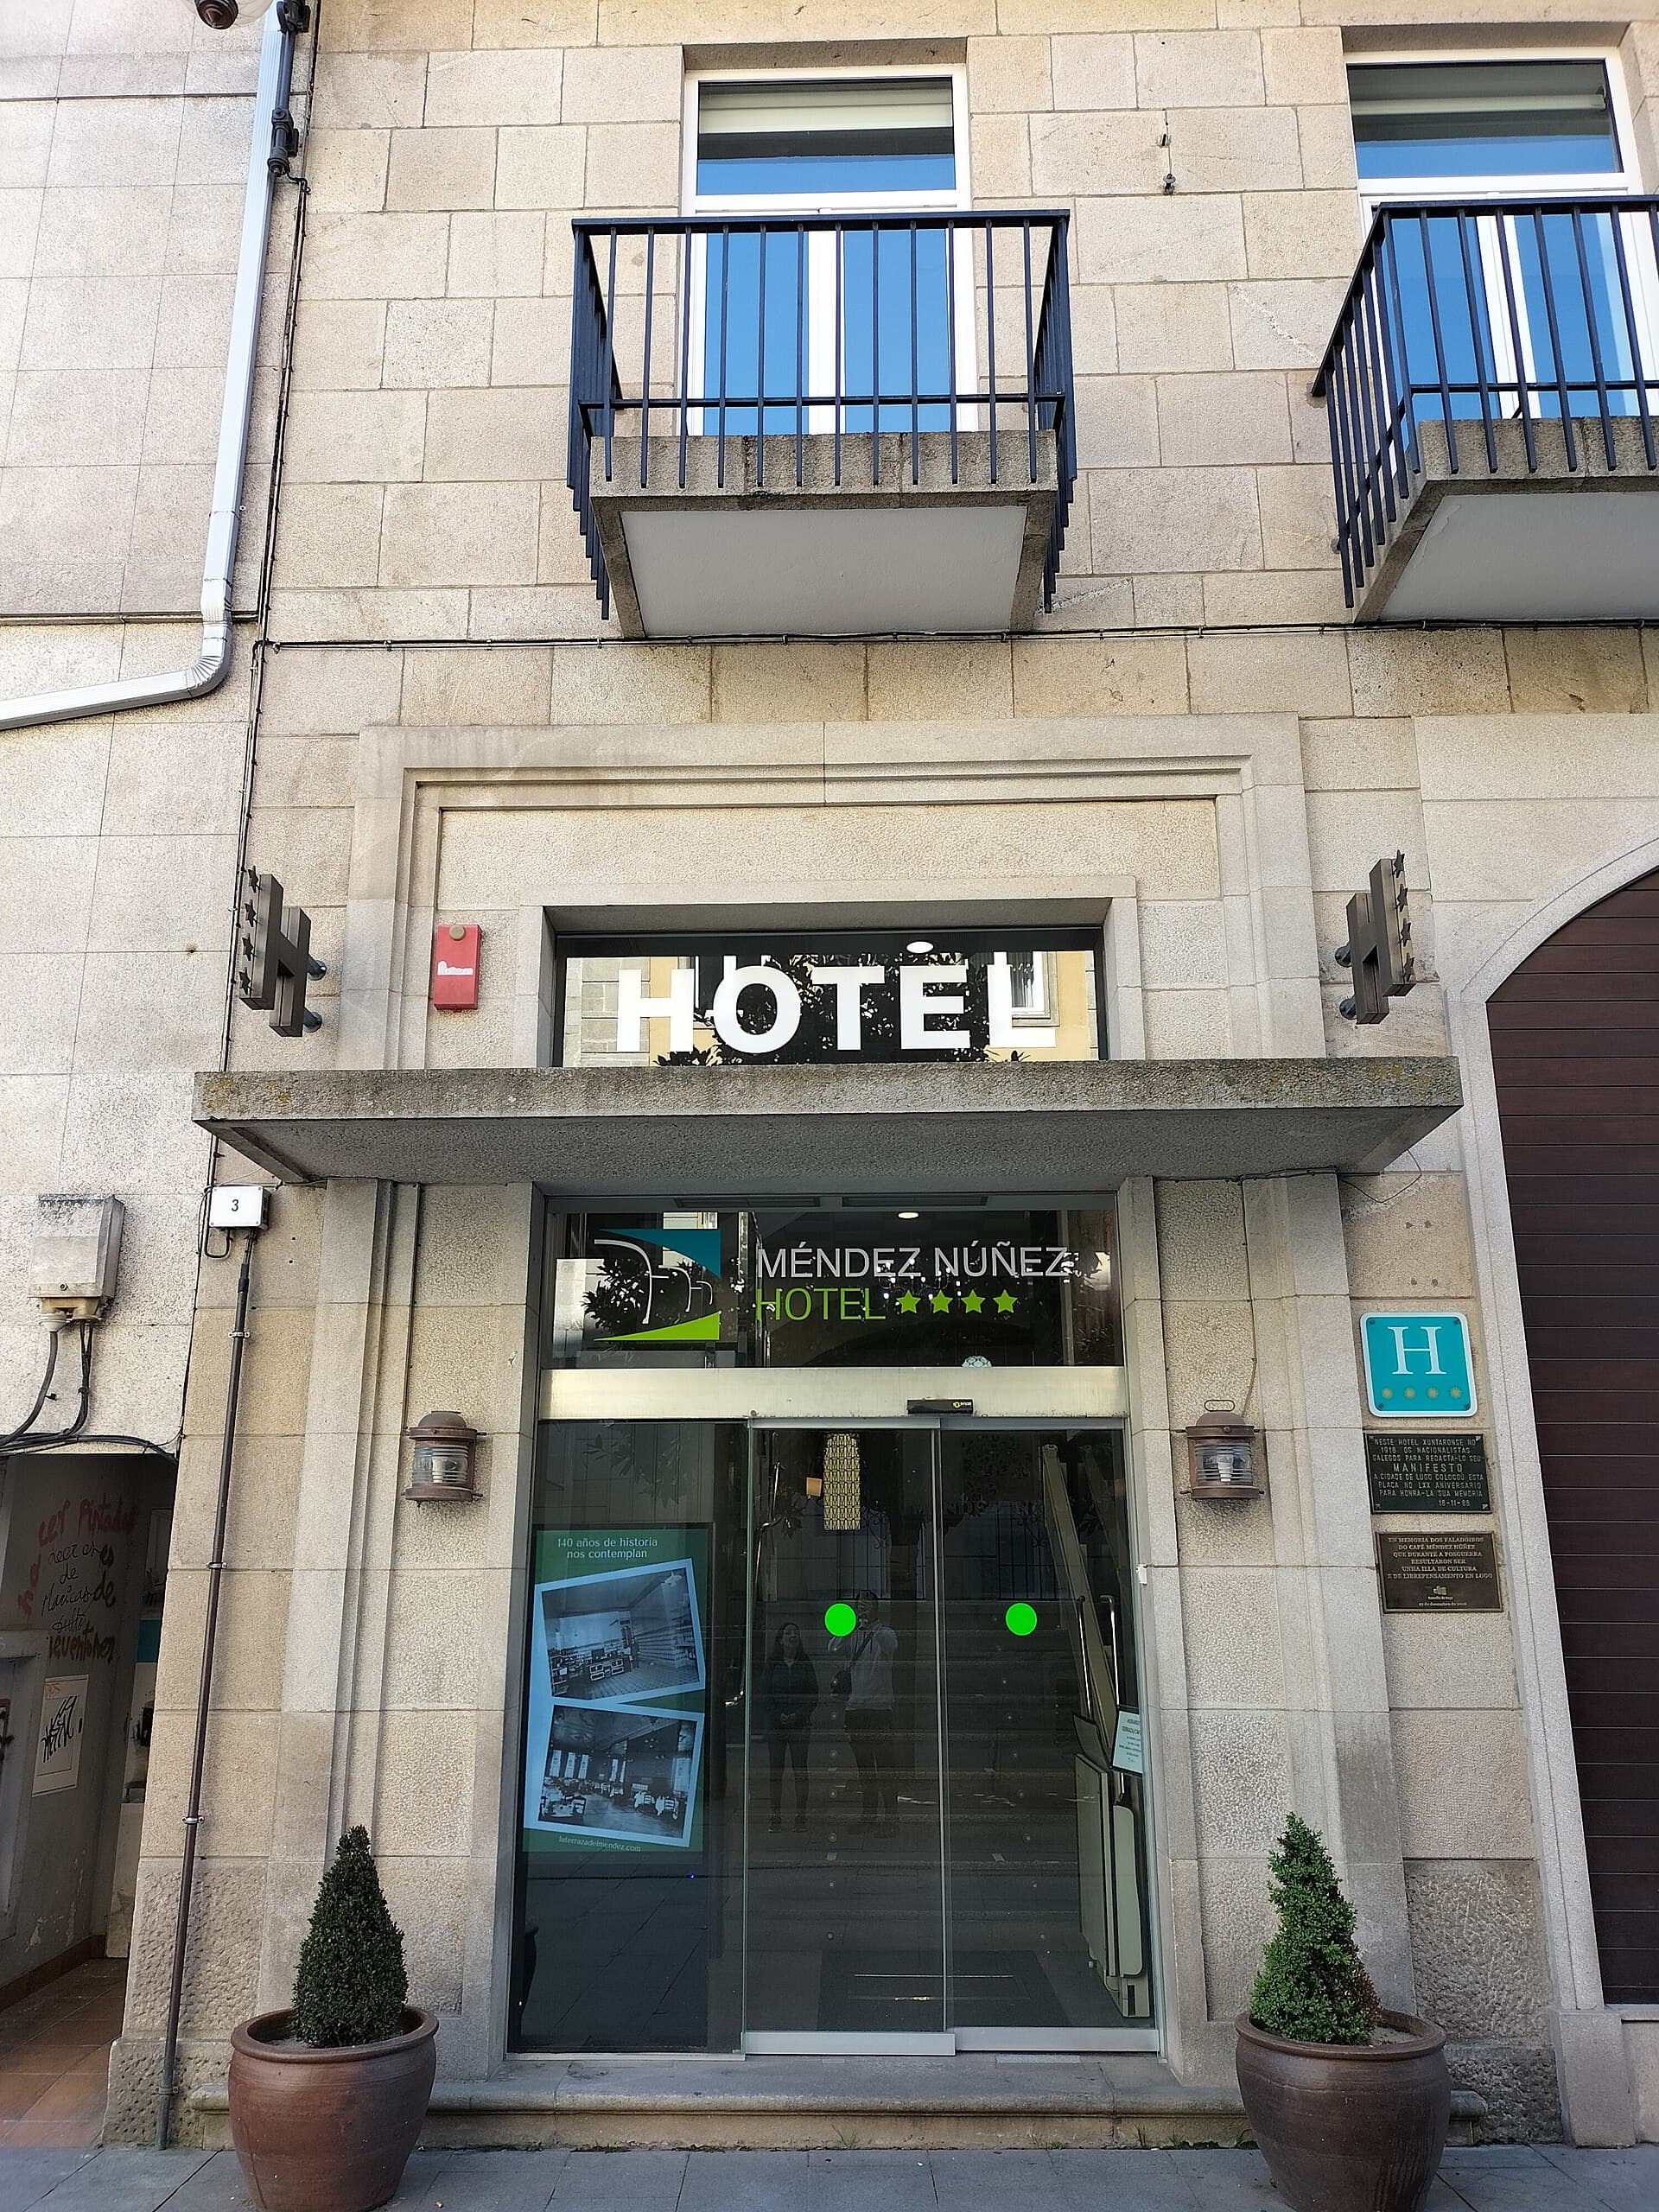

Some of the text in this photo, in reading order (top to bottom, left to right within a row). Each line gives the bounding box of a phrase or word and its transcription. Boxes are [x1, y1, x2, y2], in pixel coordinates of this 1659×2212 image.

[616, 964, 1057, 1054] HOTEL
[232, 1199, 238, 1211] 3
[758, 1241, 1068, 1278] MÉNDEZ NÚÑEZ
[756, 1288, 886, 1320] HOTEL
[1388, 1326, 1446, 1375] H
[1394, 1464, 1462, 1472] MANIFESTO
[558, 1537, 658, 1547] 140 años de historia
[588, 1549, 647, 1560] contemplan
